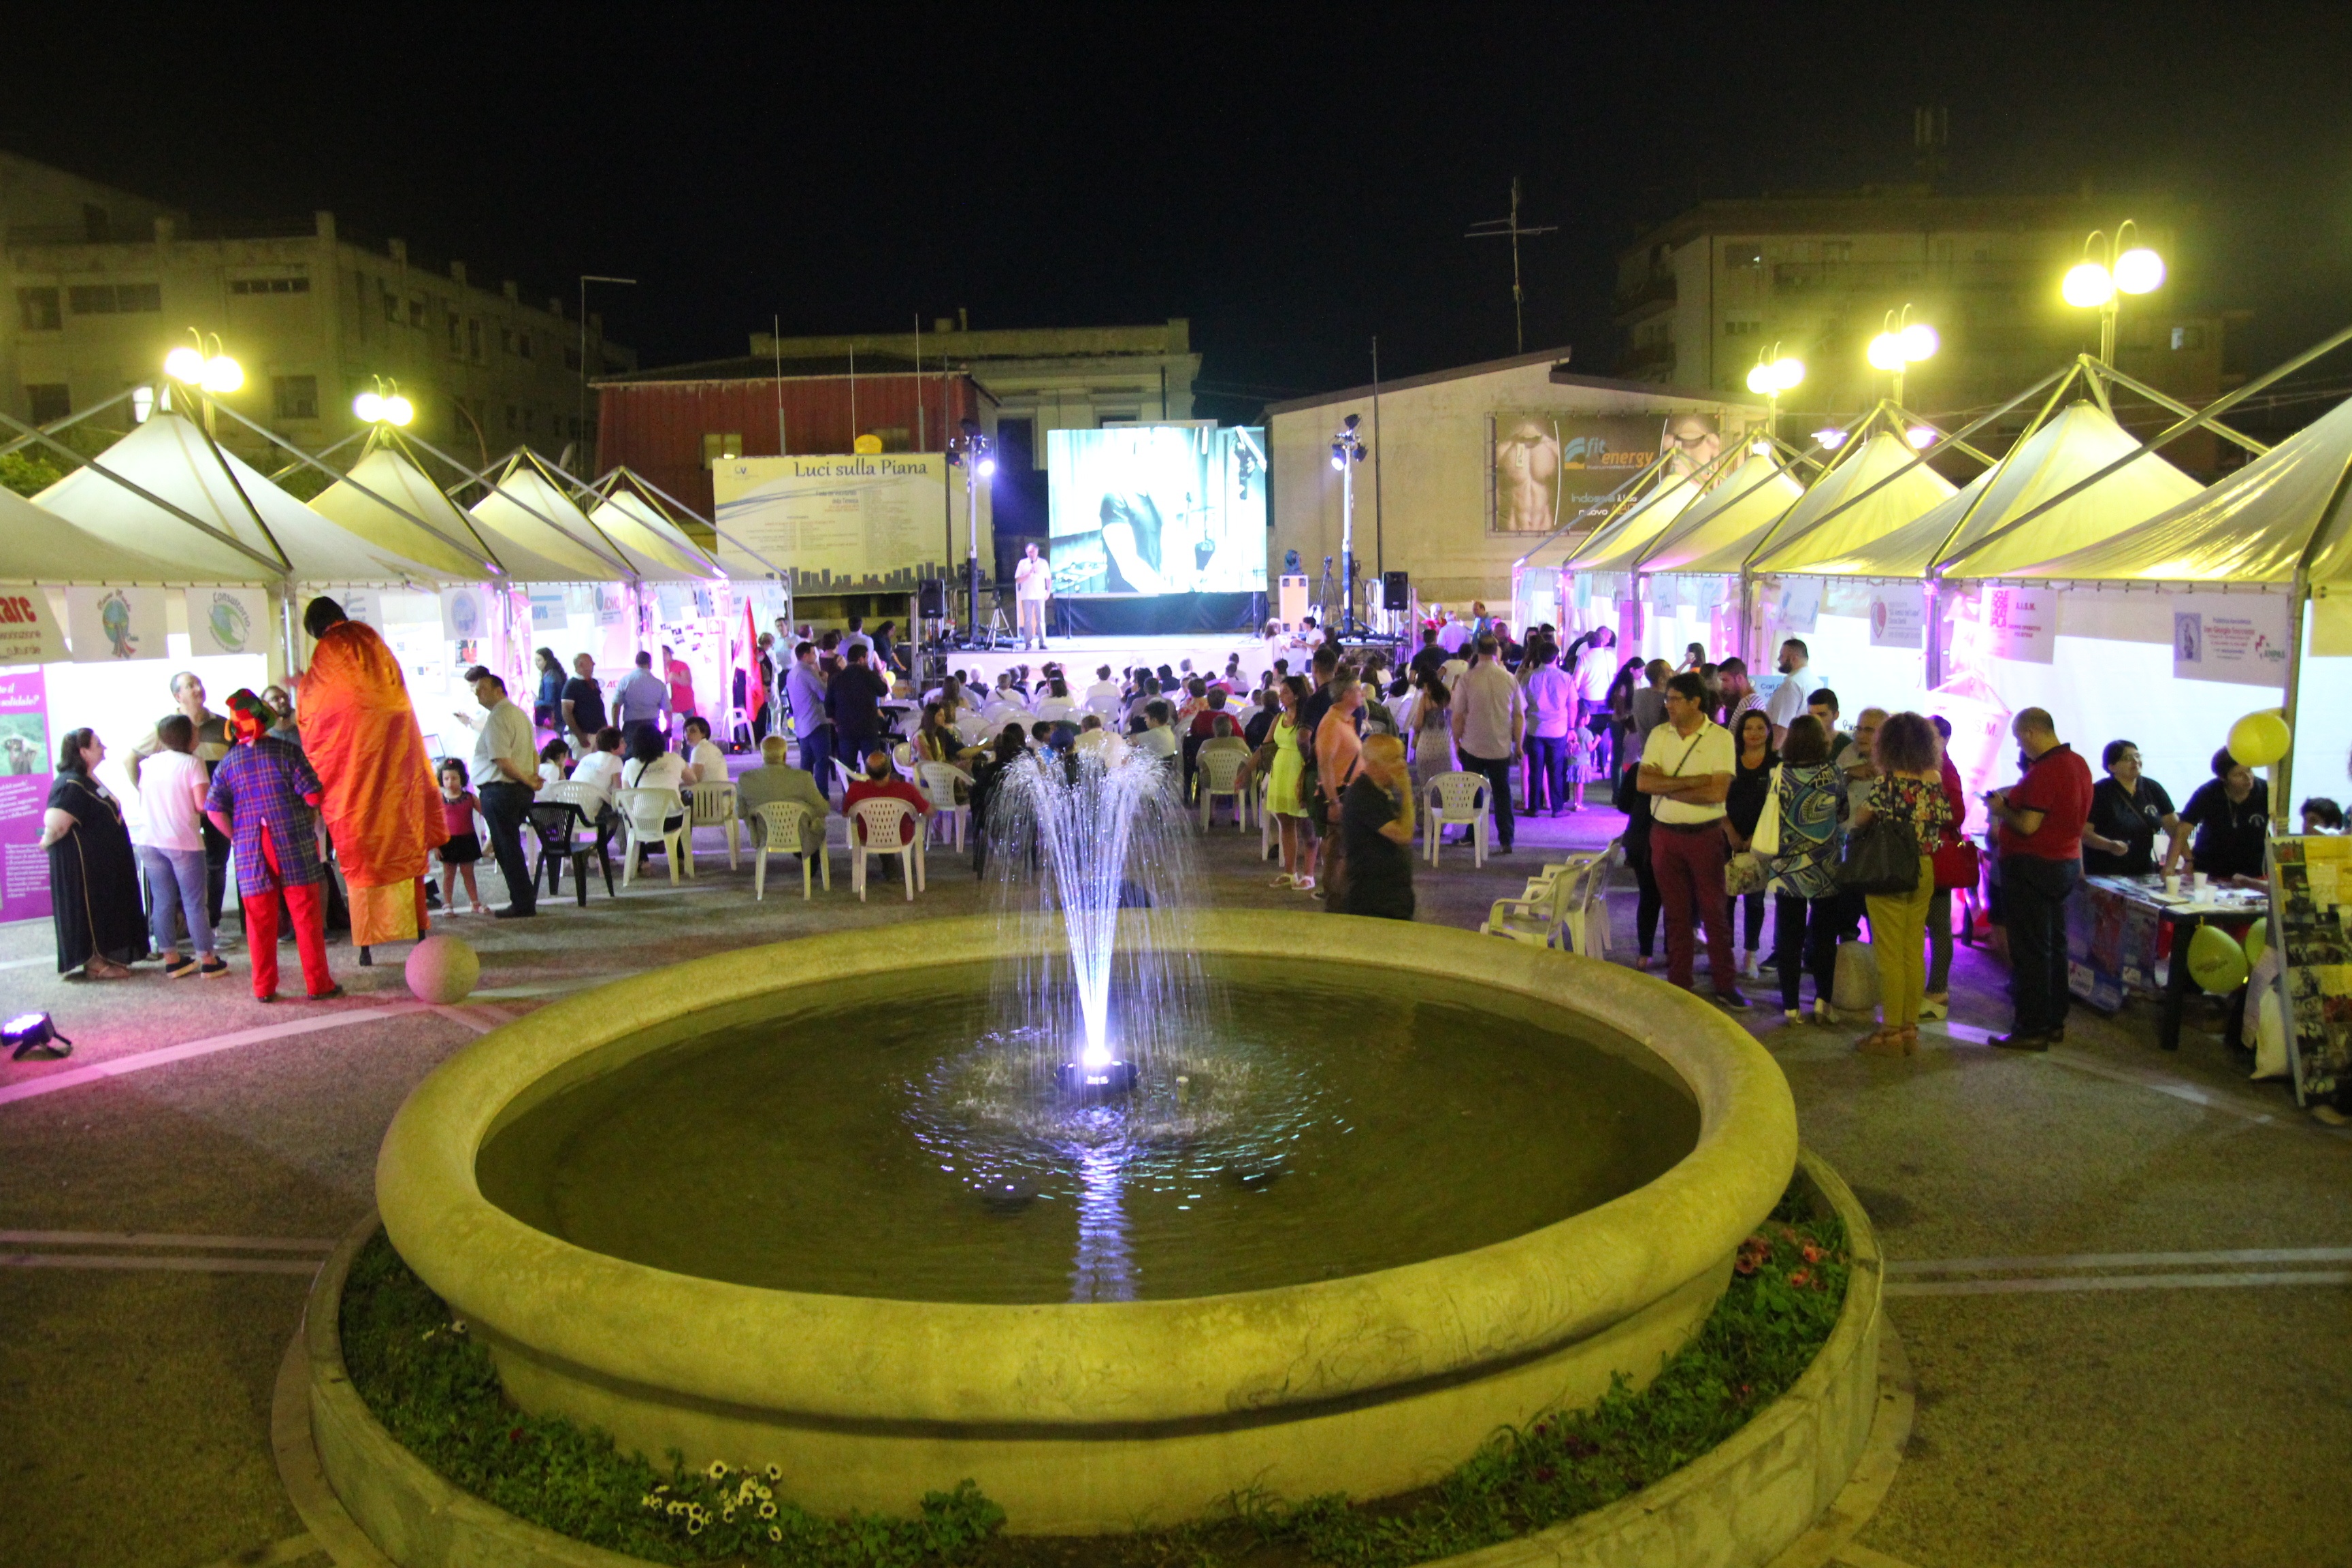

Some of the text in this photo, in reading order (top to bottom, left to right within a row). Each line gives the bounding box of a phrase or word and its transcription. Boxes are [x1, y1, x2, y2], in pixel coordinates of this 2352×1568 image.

[1586, 437, 1606, 458] fit
[794, 457, 928, 477] Luci sulla Piana
[1601, 451, 1654, 468] energy
[212, 591, 251, 628] Consultorio
[2015, 602, 2036, 611] A.I.S.M.
